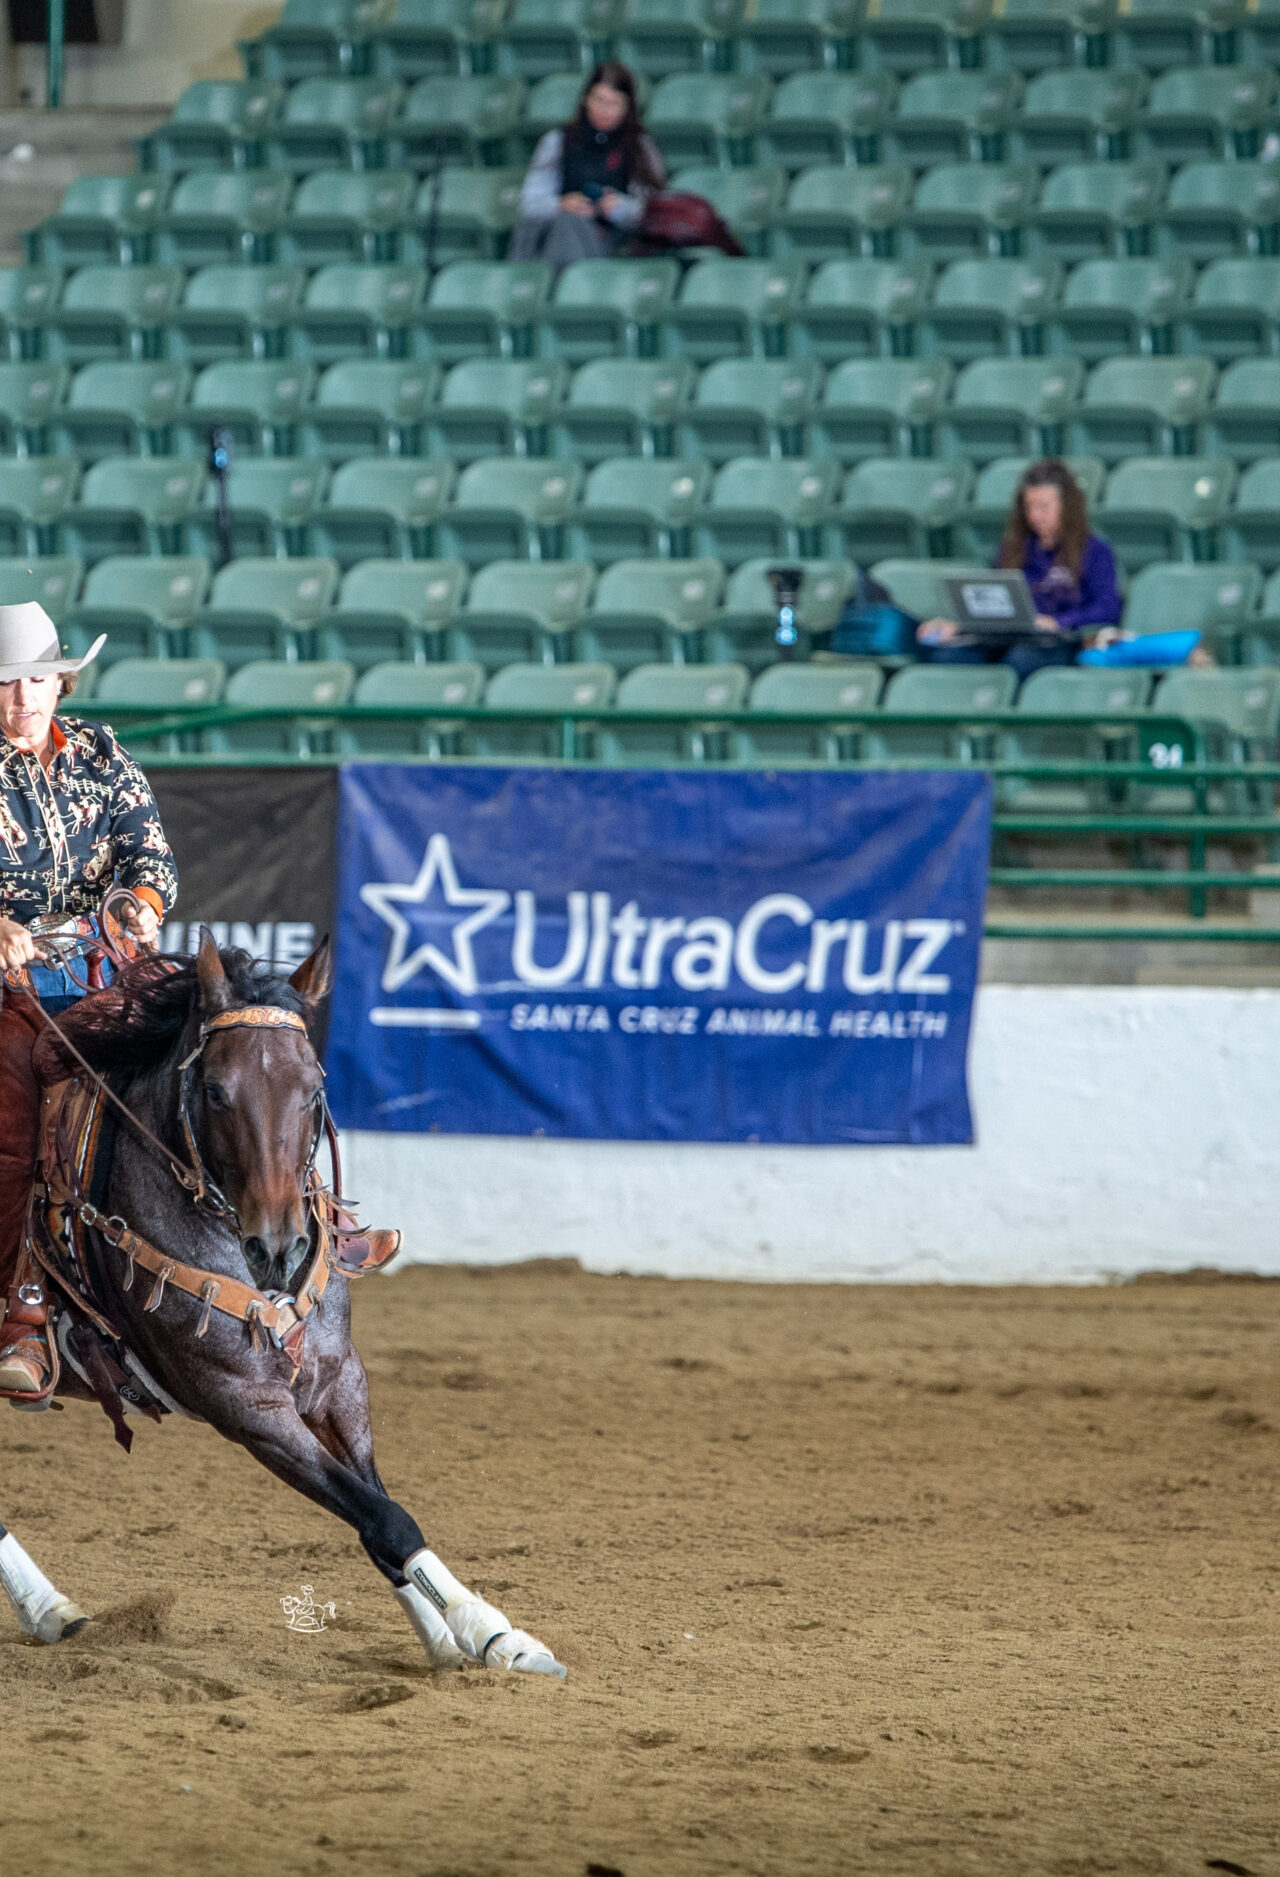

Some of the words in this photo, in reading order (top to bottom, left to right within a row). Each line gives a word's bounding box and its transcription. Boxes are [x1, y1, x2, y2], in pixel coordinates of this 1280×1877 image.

[510, 1003, 610, 1032] SANTA
[619, 1006, 699, 1034] CRUZ
[705, 1007, 820, 1037] ANIMAL
[828, 1010, 948, 1039] HEALTH
